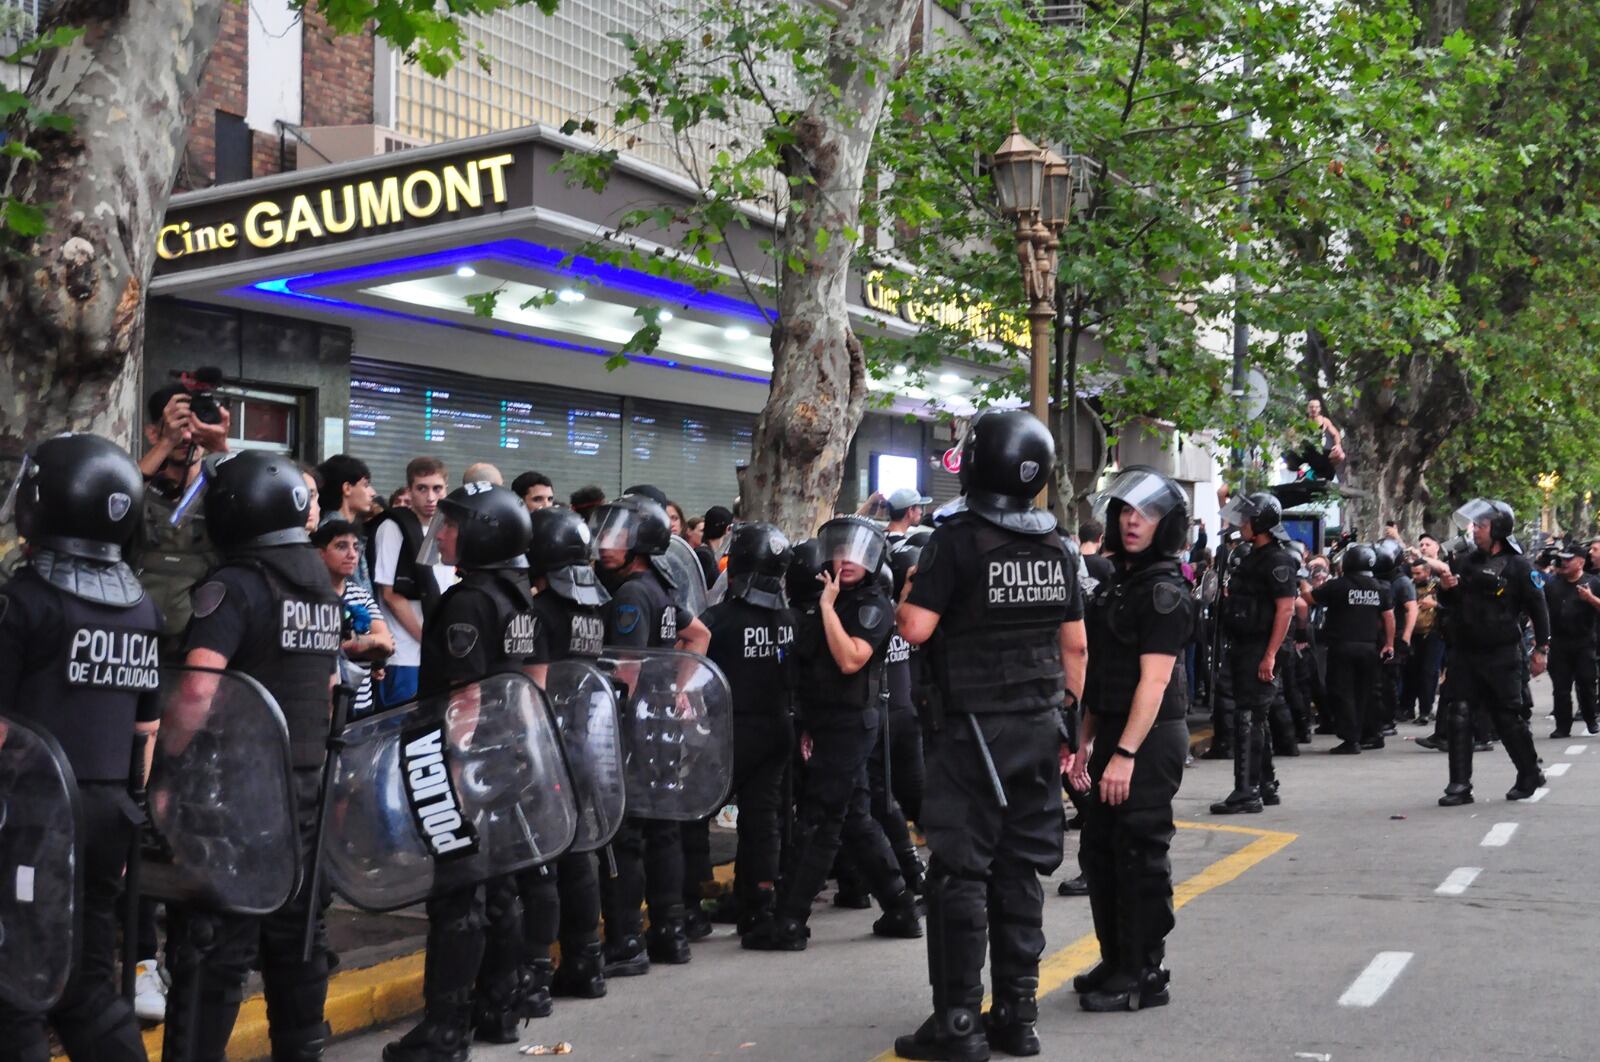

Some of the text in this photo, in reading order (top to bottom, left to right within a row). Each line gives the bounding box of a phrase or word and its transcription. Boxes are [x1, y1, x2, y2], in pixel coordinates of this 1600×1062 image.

[156, 153, 514, 261] Cine GAUMONT
[988, 561, 1066, 586] POLICIA
[988, 586, 1066, 603] DE LA CIUDAD
[1349, 589, 1379, 599] POLICIA
[282, 600, 342, 632] POLICIA
[70, 628, 159, 667] POLICIA
[281, 630, 340, 651] DE LA CIUDAD
[744, 626, 794, 646] POLCIA
[744, 646, 758, 658] DE
[759, 645, 771, 657] LA
[68, 663, 159, 689] DE LA CIUDAD
[406, 728, 472, 855] POLICIA
